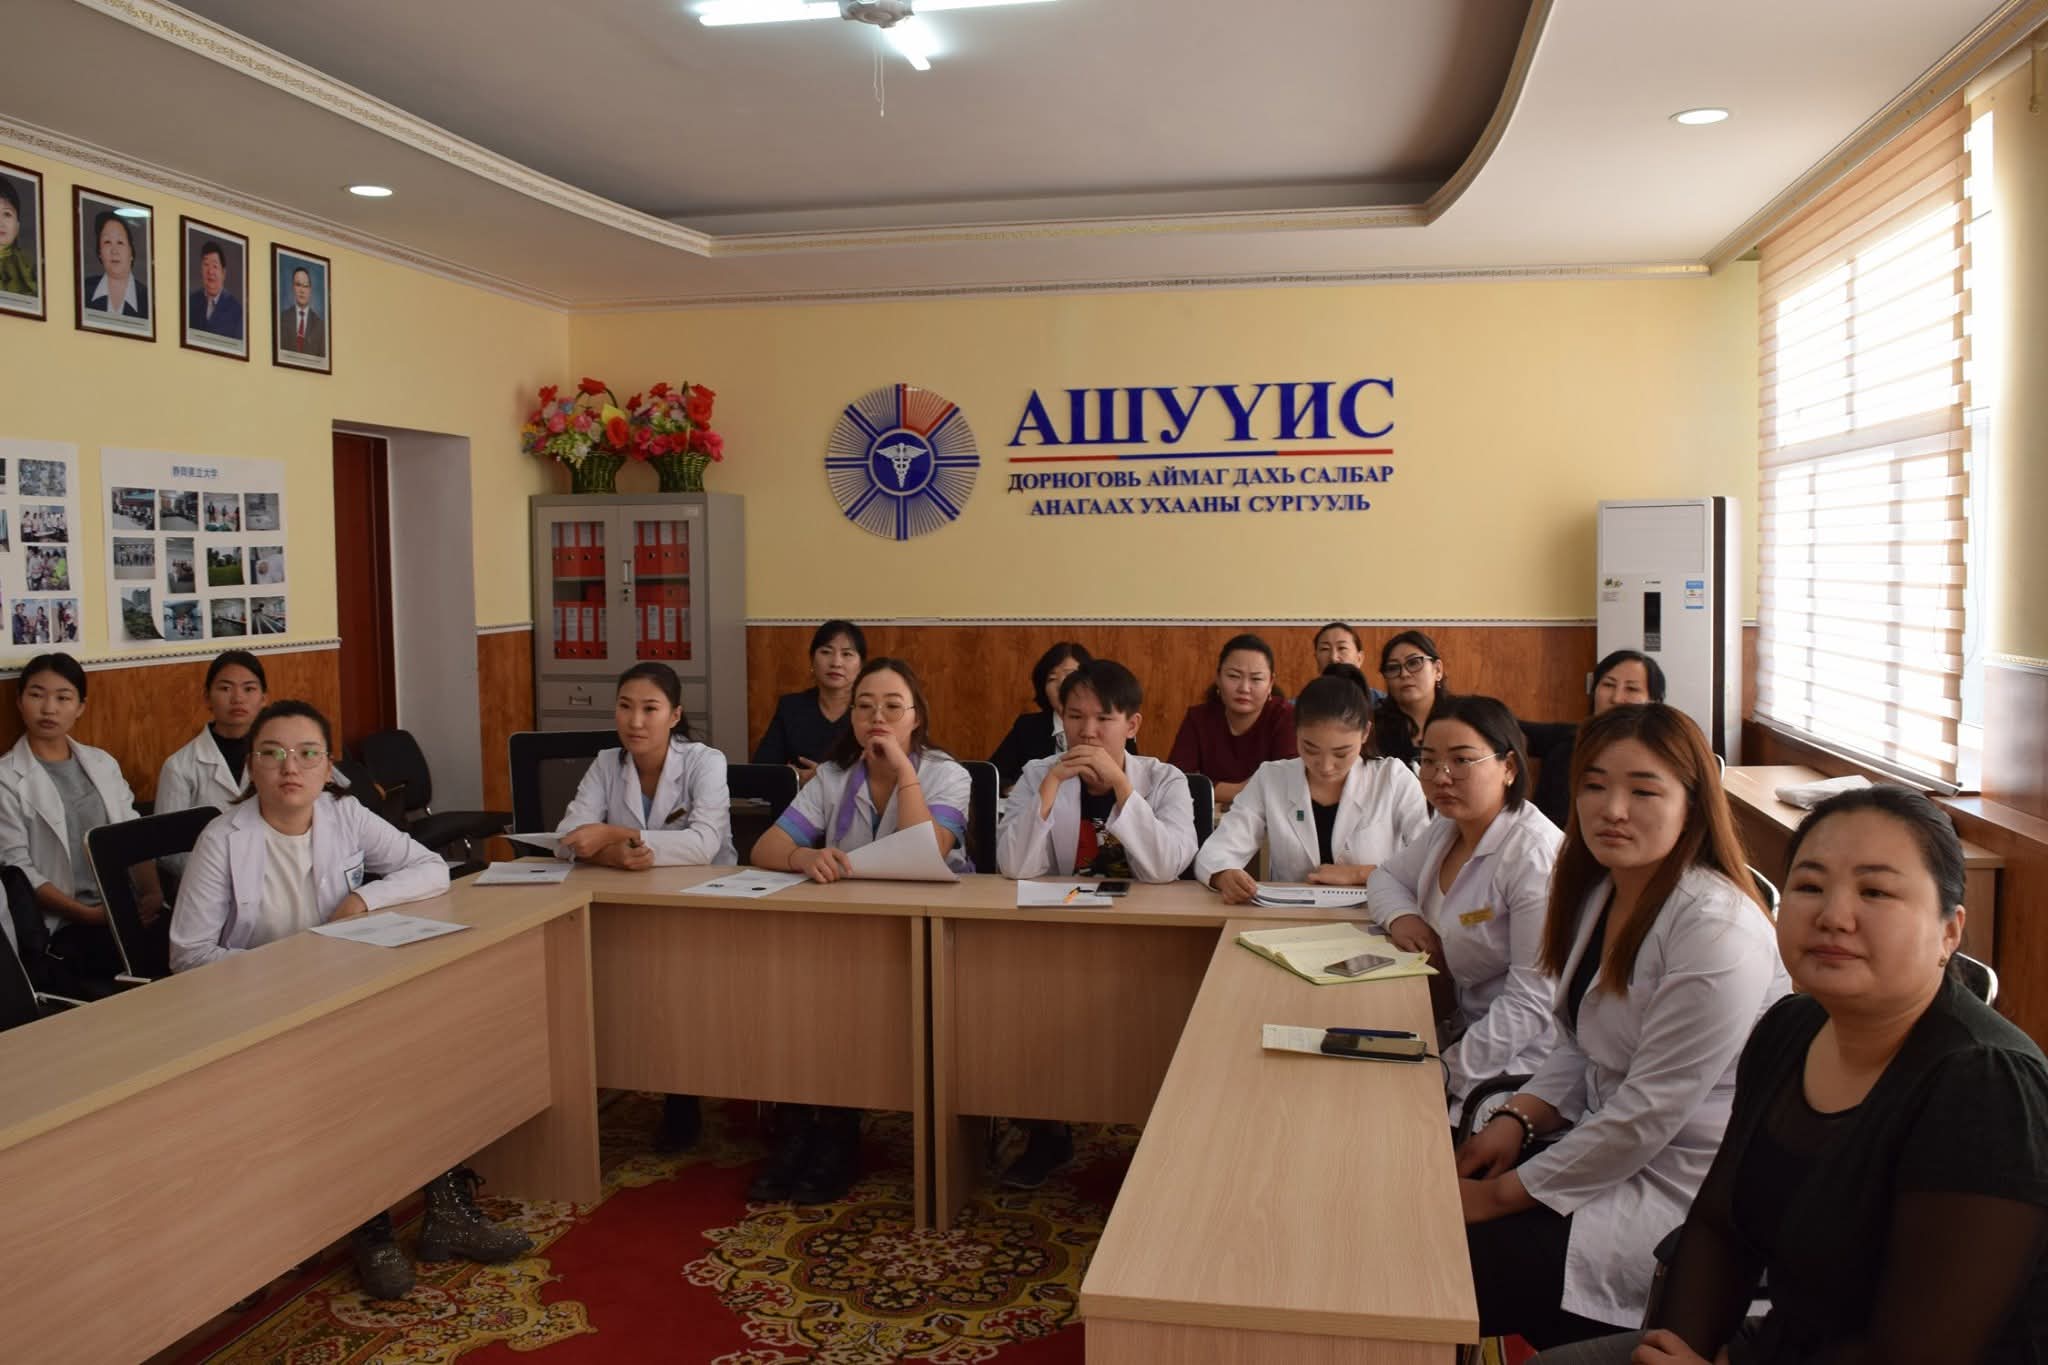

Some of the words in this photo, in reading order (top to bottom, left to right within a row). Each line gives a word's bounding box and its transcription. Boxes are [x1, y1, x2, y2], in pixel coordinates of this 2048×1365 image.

[1007, 378, 1395, 448] АШУҮИС
[1009, 470, 1142, 493] ДОРНОГОВЬ
[1147, 466, 1230, 488] АЙМАГ
[1233, 466, 1296, 487] ДАХЬ
[1299, 465, 1394, 484] САЛБАР
[1031, 497, 1134, 517] АНАГААХ
[1139, 495, 1241, 515] УХААНЫ
[1247, 493, 1371, 513] СУРГУУЛЬ
